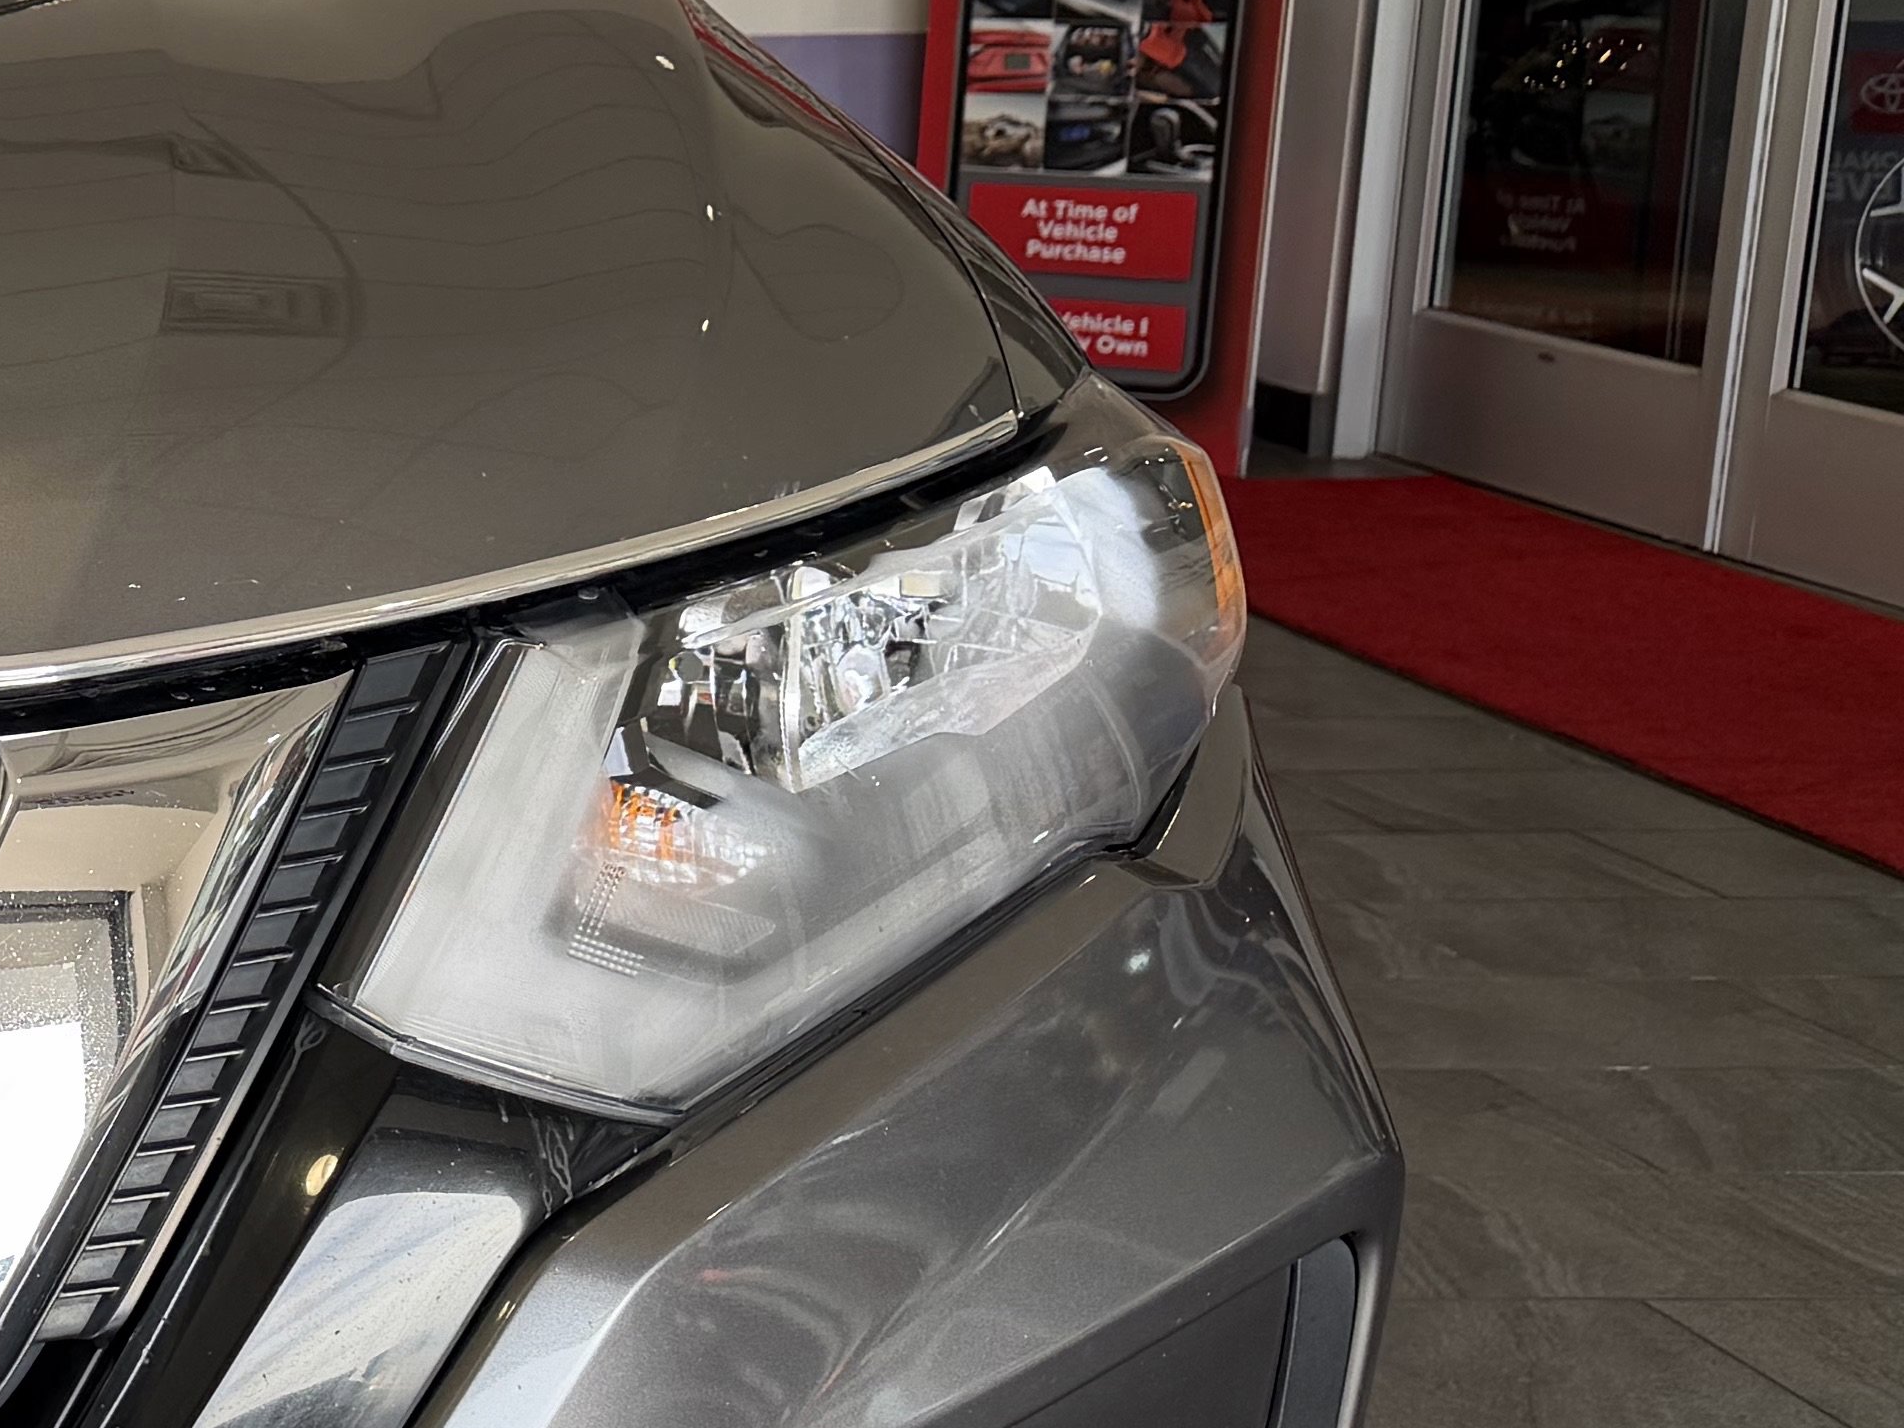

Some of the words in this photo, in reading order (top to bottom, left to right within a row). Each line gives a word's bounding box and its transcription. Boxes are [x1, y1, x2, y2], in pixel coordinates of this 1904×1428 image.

[1021, 198, 1048, 219] At
[1055, 199, 1108, 221] Time
[1112, 202, 1140, 224] of
[1036, 219, 1119, 243] Vehicle
[1026, 239, 1127, 265] Purchase
[1096, 334, 1148, 358] Own
